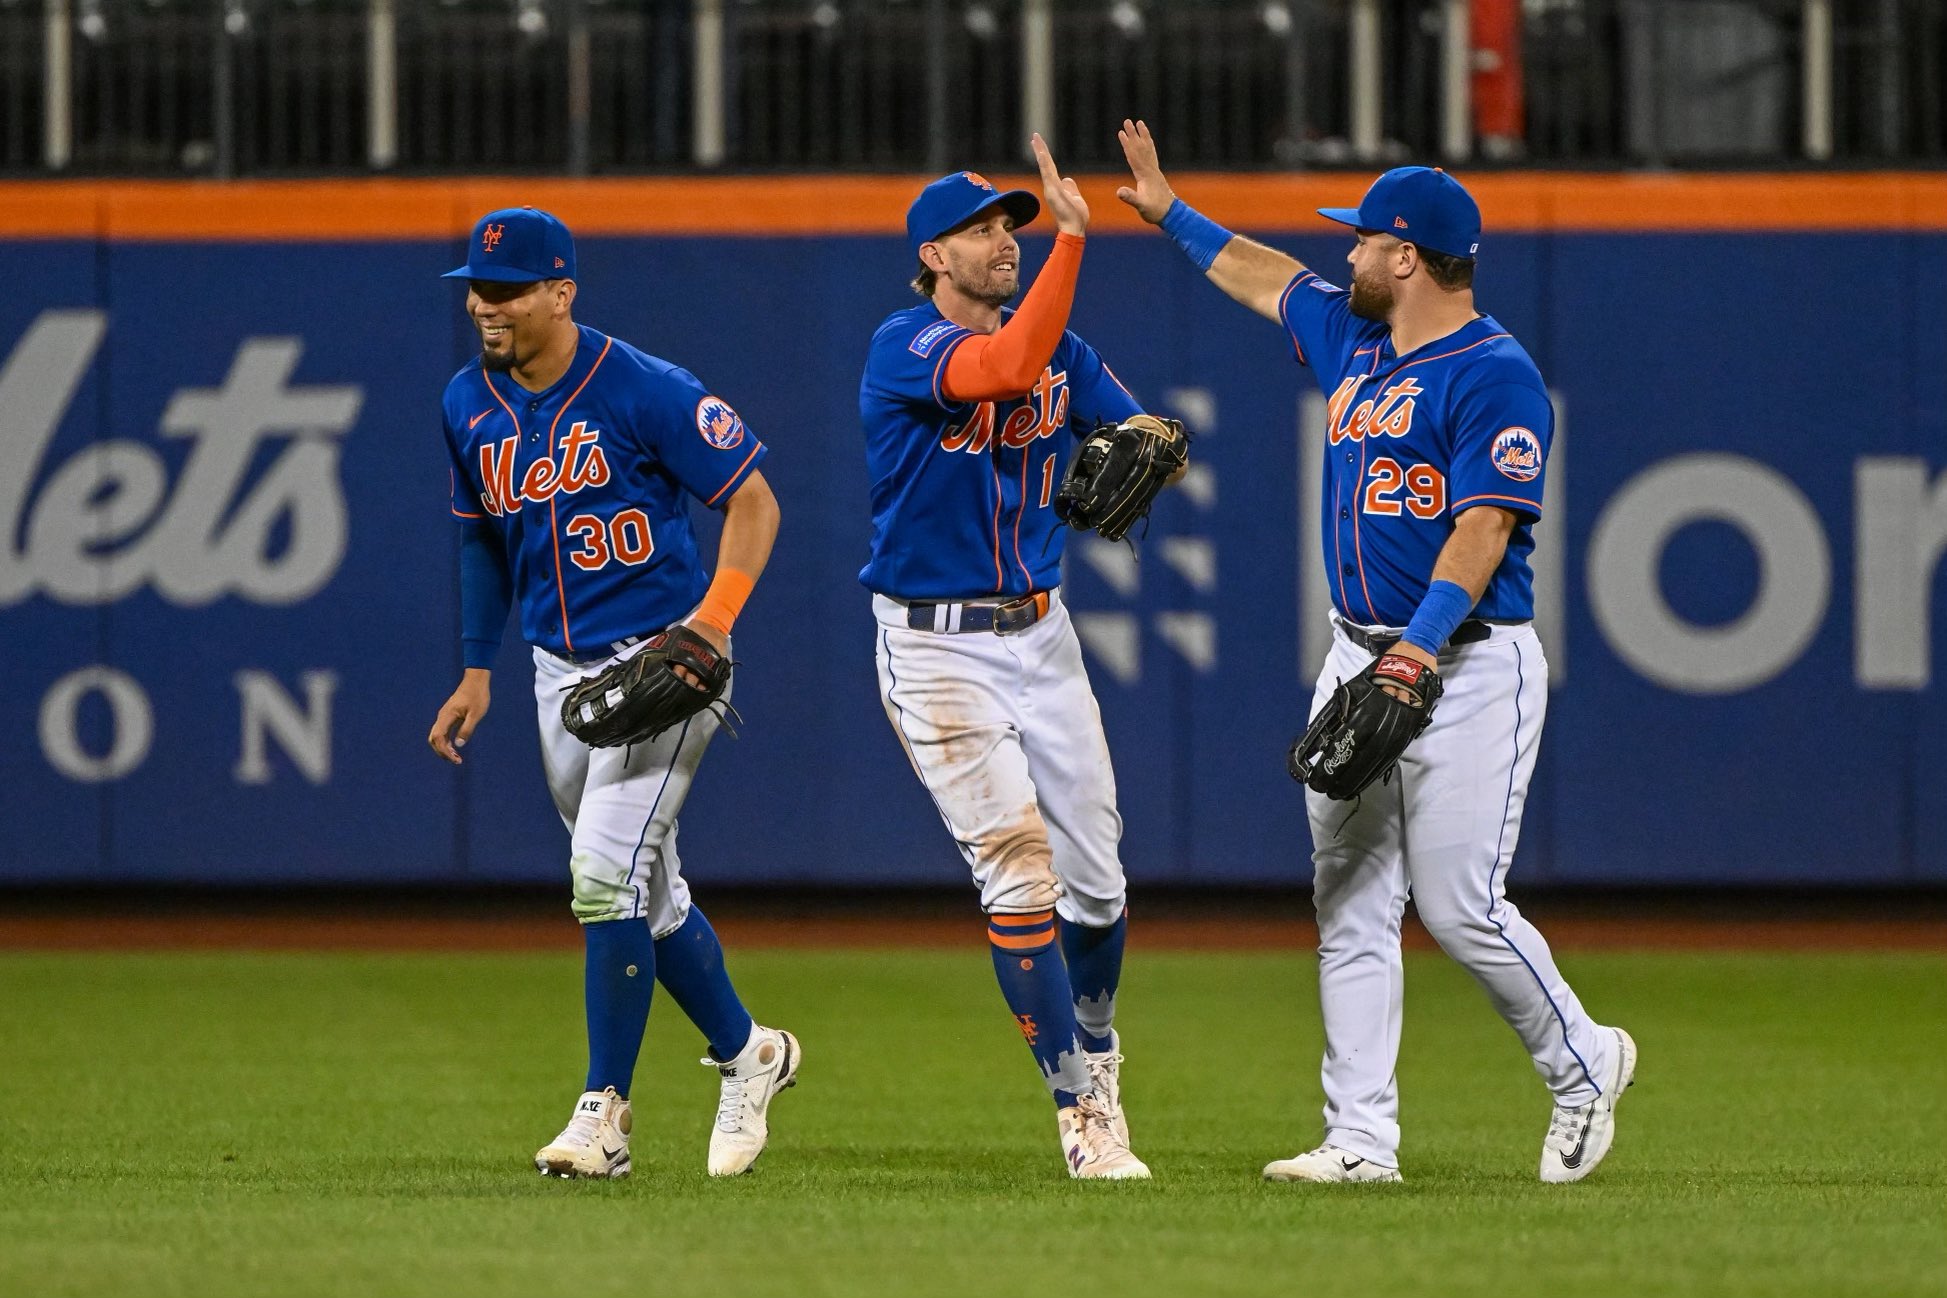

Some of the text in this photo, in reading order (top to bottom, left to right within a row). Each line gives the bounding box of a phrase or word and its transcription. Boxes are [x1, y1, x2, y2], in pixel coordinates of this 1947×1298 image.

[1327, 374, 1425, 446] Mets
[479, 420, 611, 518] Mets
[1039, 453, 1057, 509] 1
[1363, 456, 1446, 520] 29
[565, 508, 655, 571] 30
[1323, 728, 1355, 775] Rawlings
